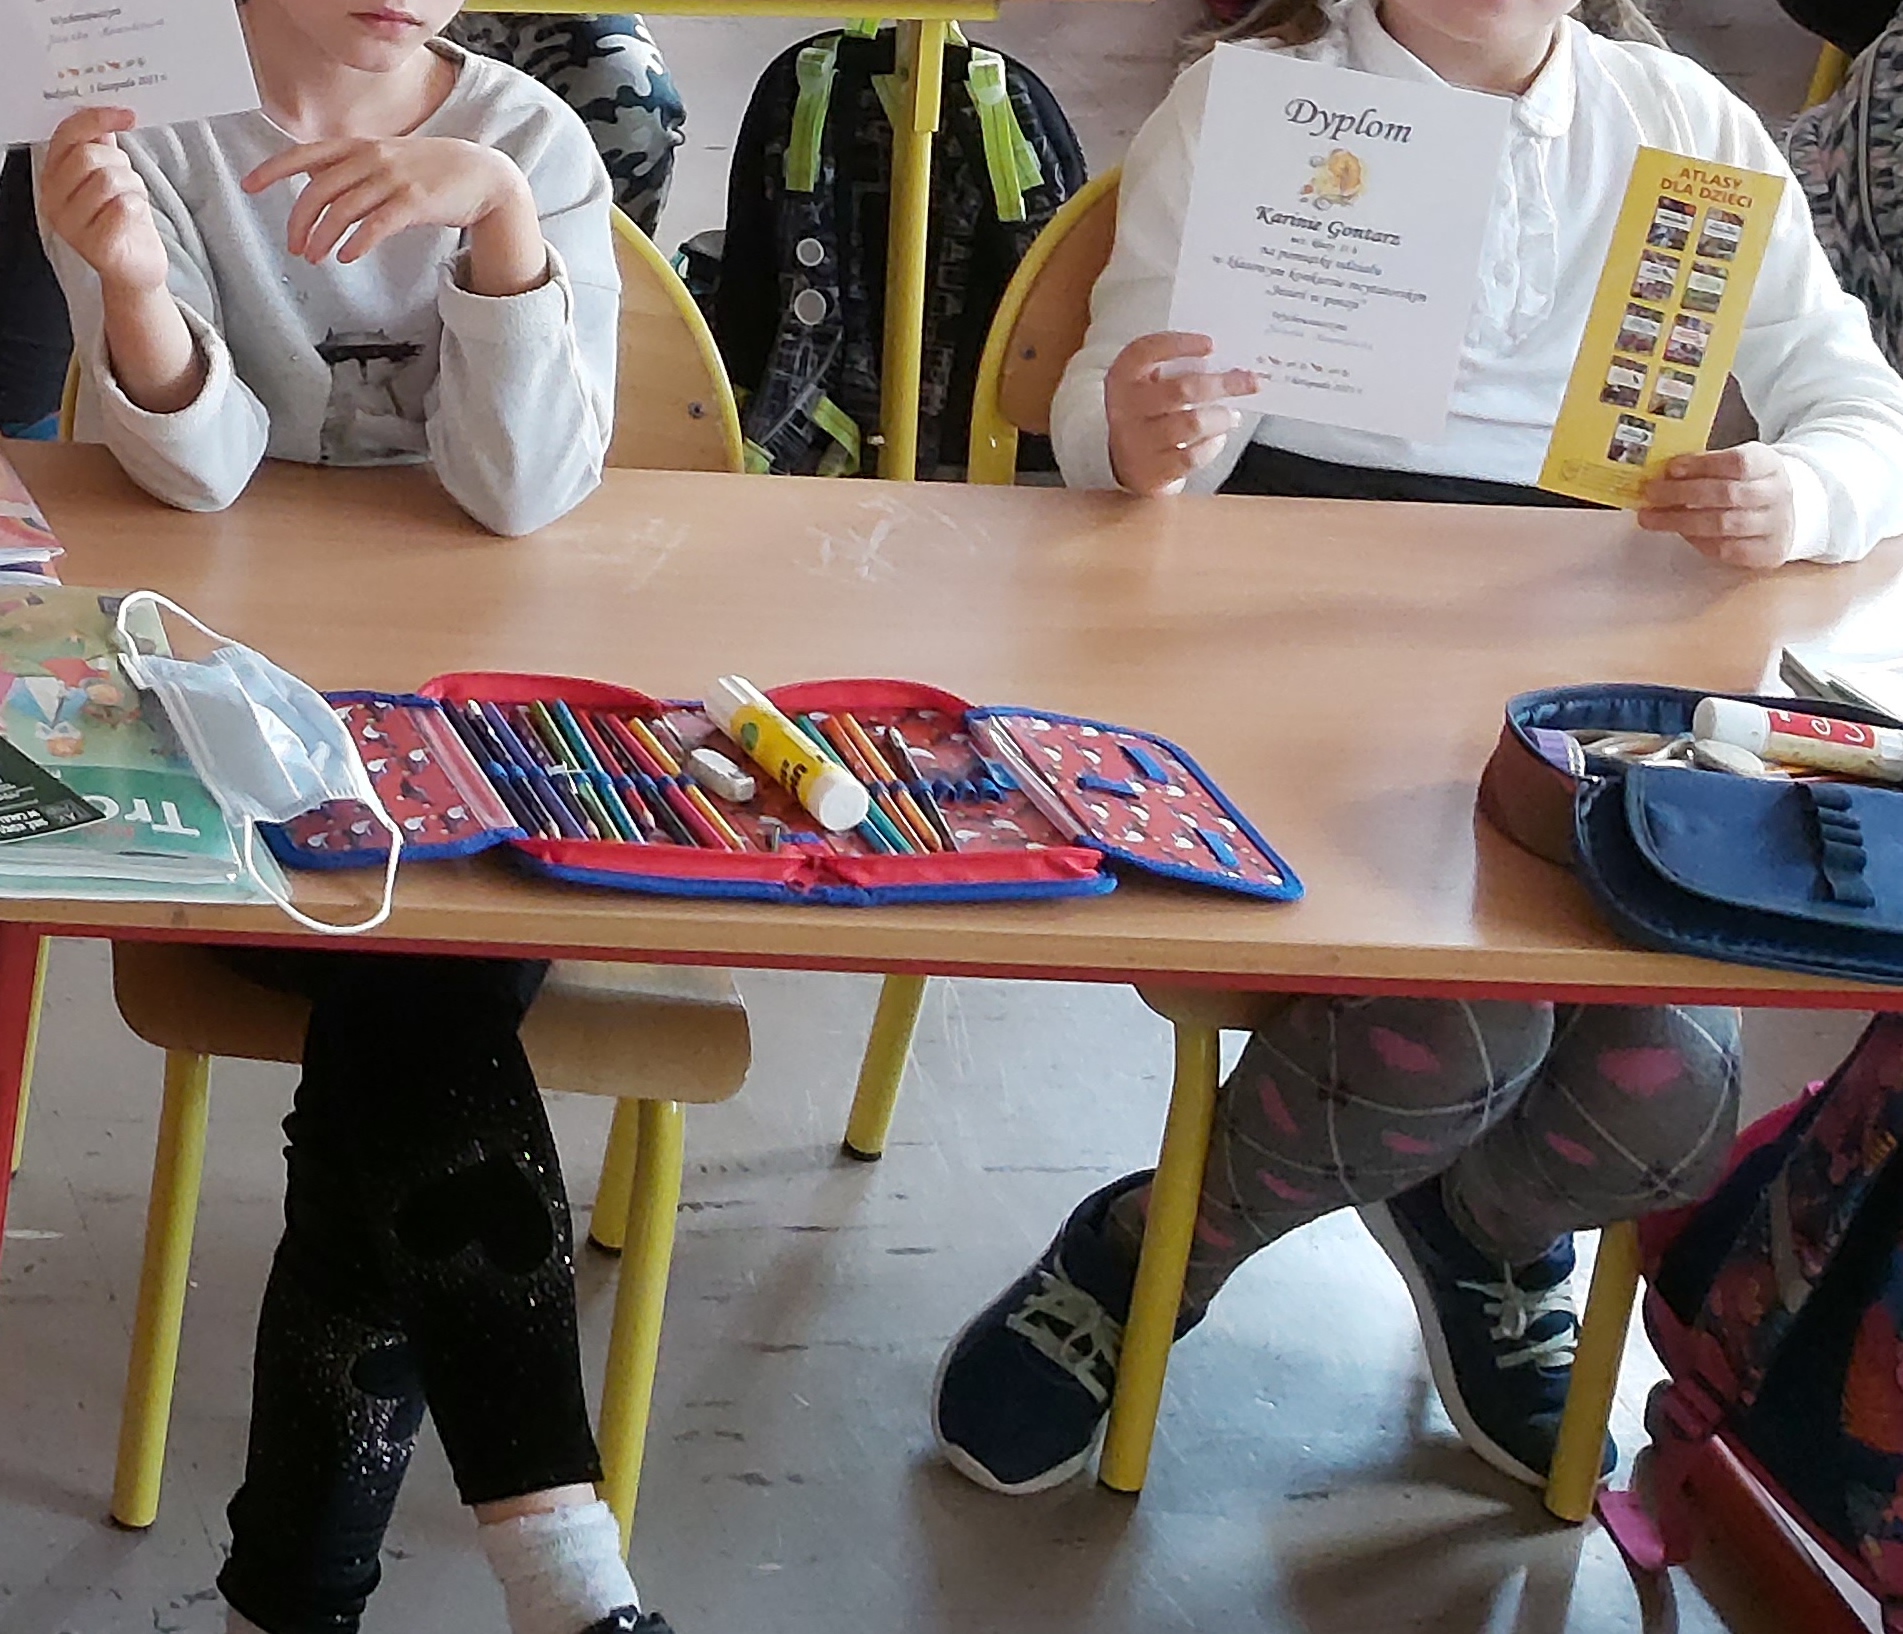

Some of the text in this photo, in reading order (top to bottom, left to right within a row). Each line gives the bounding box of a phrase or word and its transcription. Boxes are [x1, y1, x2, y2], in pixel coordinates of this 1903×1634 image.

[1284, 97, 1414, 144] Dyplom
[1660, 177, 1754, 210] DLA DZIECI
[1679, 167, 1744, 190] ATLASY
[1255, 205, 1402, 247] Karinie Gontarz
